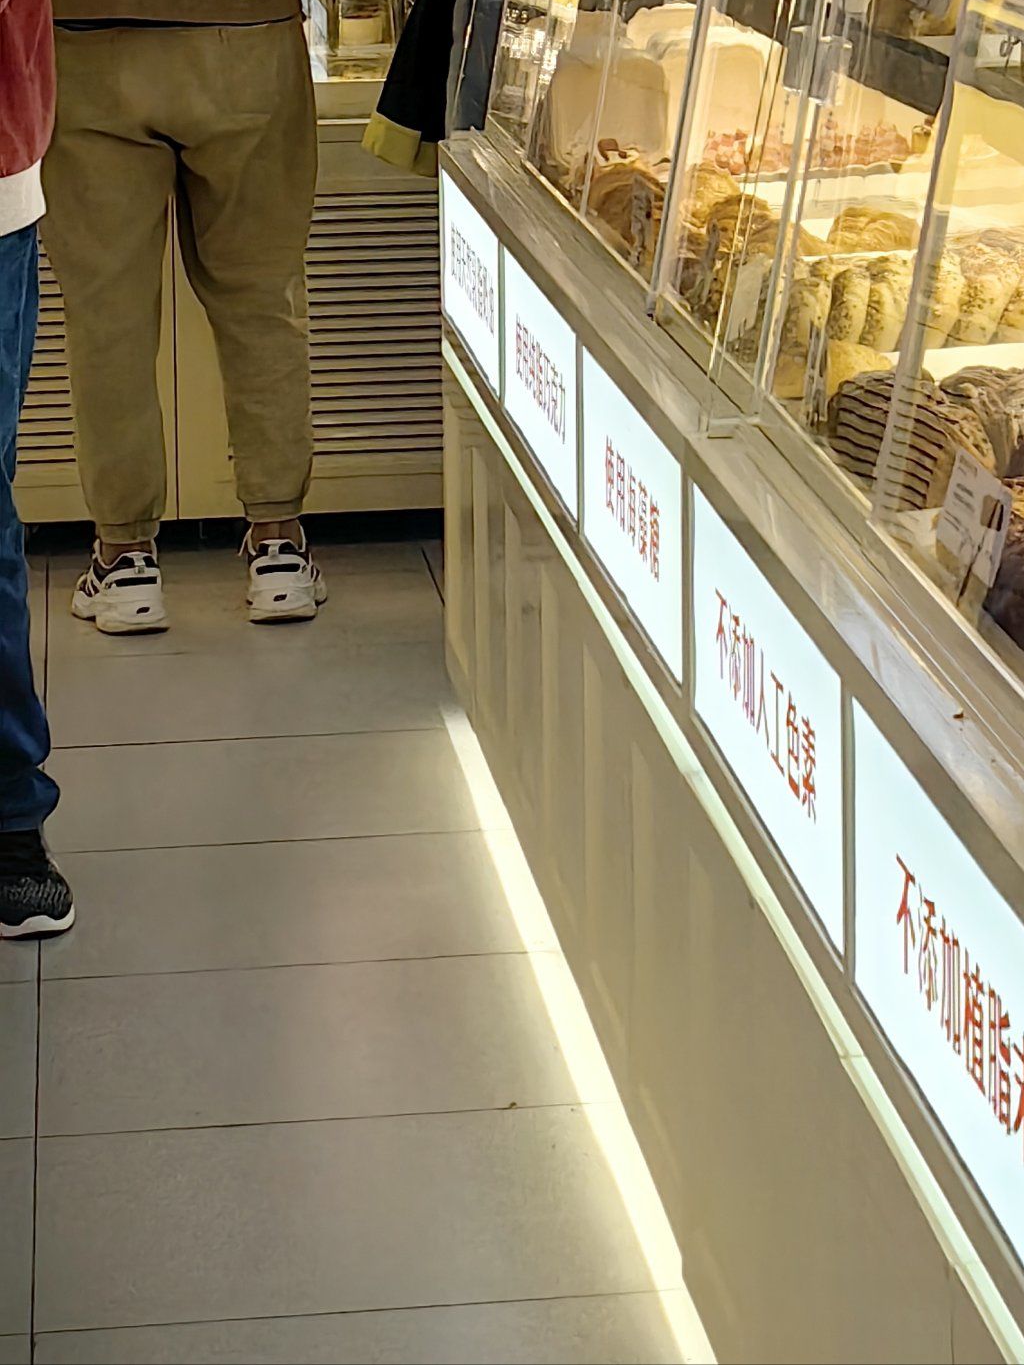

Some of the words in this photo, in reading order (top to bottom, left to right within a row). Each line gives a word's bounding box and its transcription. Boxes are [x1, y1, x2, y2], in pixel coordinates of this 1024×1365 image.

[714, 586, 817, 825] 不添加人工色素
